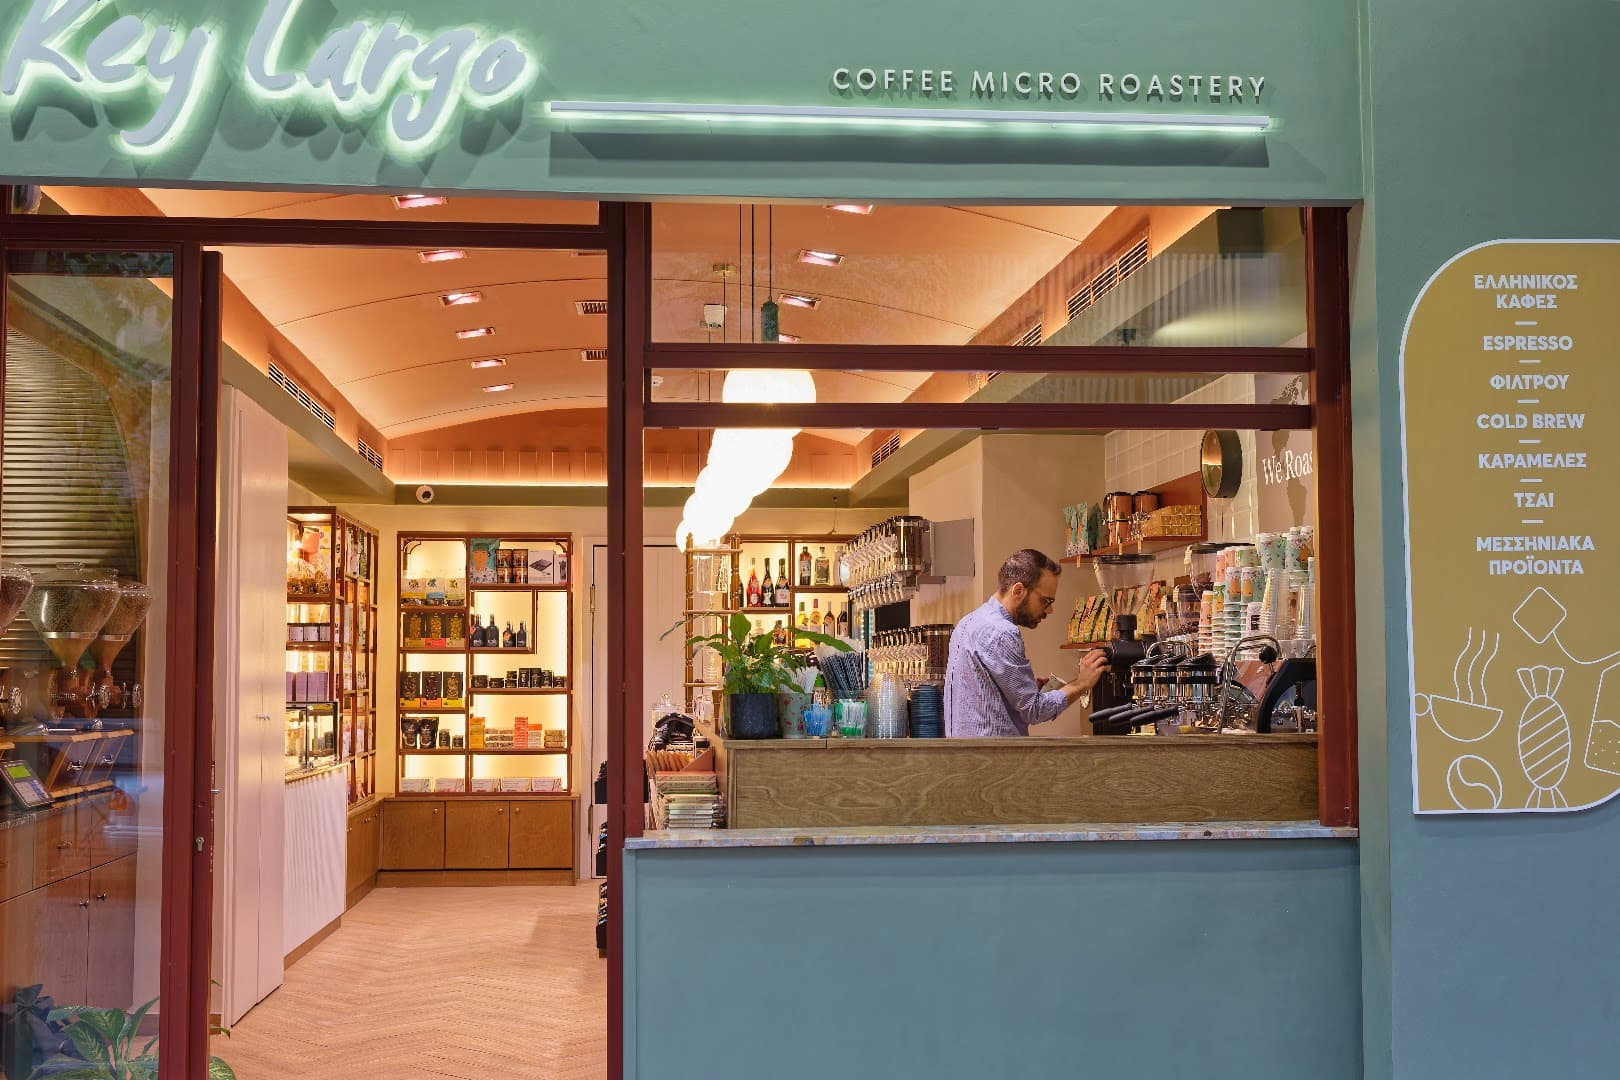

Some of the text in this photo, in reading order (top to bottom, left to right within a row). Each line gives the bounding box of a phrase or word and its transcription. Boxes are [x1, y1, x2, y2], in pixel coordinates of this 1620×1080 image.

[0, 0, 528, 145] Key Largo
[833, 68, 1265, 97] COFFEE MICRO ROASTERY
[1474, 274, 1578, 290] ΕΛΛΗΝΙΚΟΣ
[1496, 294, 1558, 309] ΚΑΦΕΣ
[1483, 335, 1573, 351] ESPRESSO
[1490, 374, 1570, 389] ΦΙΛΤΡΟΥ
[1476, 413, 1585, 429] COLD BREW
[1478, 453, 1587, 469] ΚΑΡΑΜΕΛΕΣ
[1262, 455, 1283, 485] We
[1514, 492, 1554, 508] ΤΣΑΙ
[1476, 535, 1595, 552] ΜΕΣΣΗΝΙΑΚΑ
[1488, 555, 1585, 576] ΠΡΟΪΟΝΤΑ
